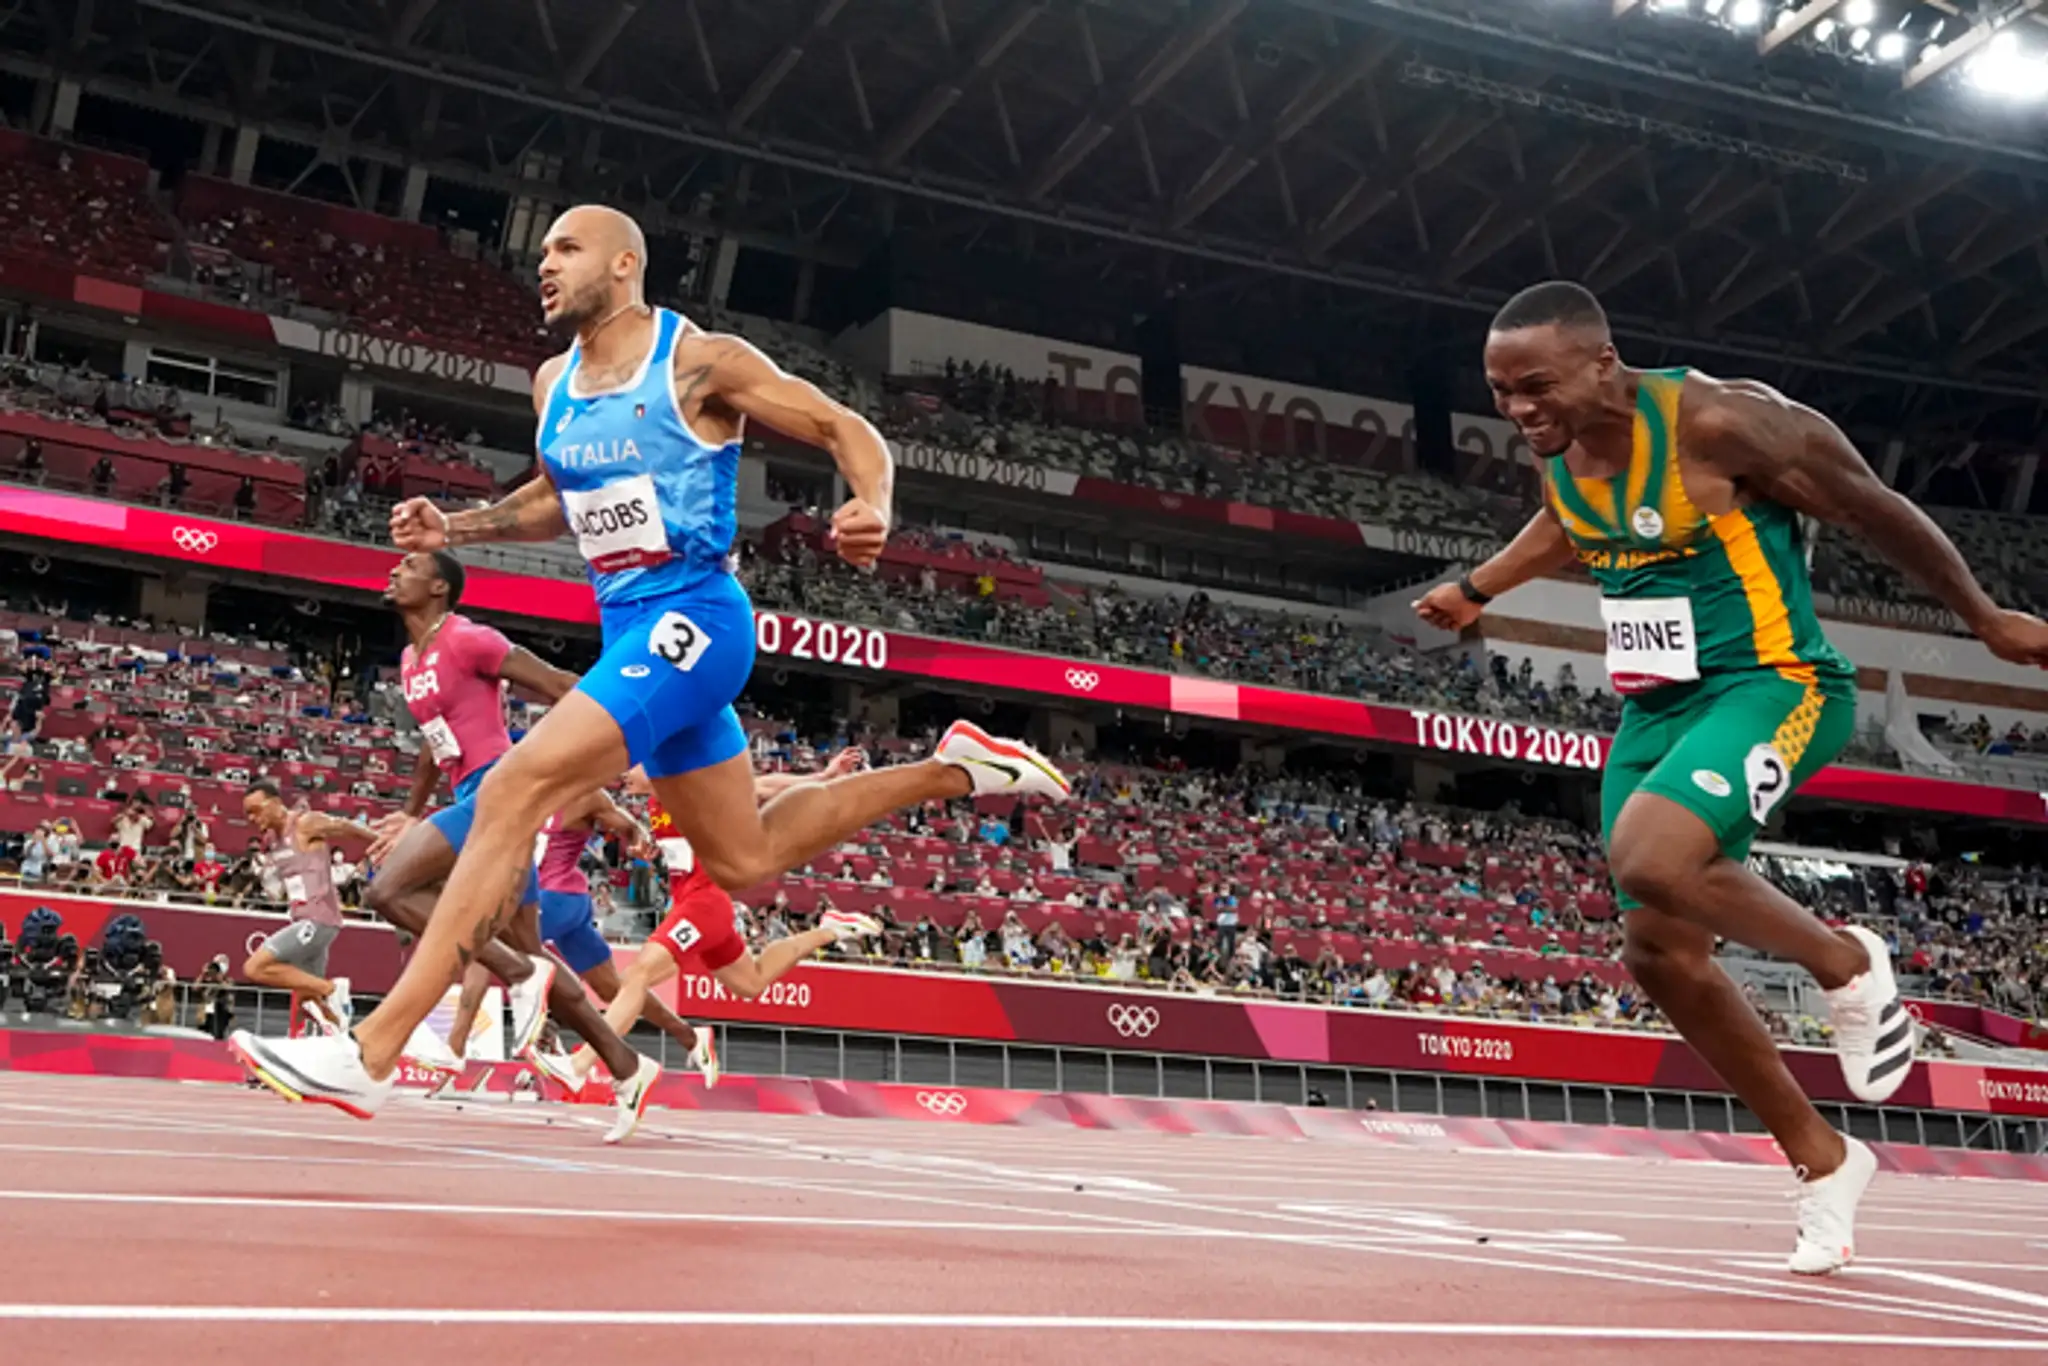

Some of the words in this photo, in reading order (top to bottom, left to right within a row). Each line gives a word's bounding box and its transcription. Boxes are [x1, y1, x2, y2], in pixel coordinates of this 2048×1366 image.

[314, 329, 414, 371] TOKYO
[425, 349, 496, 387] 2020
[560, 438, 643, 469] ITALIA
[899, 443, 978, 479] TOKYO
[986, 457, 1046, 490] 2020
[657, 622, 696, 666] 3
[791, 617, 887, 670] 2020
[403, 669, 440, 704] USA
[1410, 710, 1518, 760] TOKYO
[1524, 725, 1602, 770] 2020
[1753, 757, 1783, 812] 2
[675, 925, 693, 945] 6
[683, 973, 753, 1002] TOK
[758, 981, 812, 1009] 2020
[1417, 1032, 1473, 1058] TOKYO
[1473, 1038, 1514, 1061] 2020
[1977, 1079, 2023, 1102] TOKYO
[2024, 1083, 2048, 1104] 202
